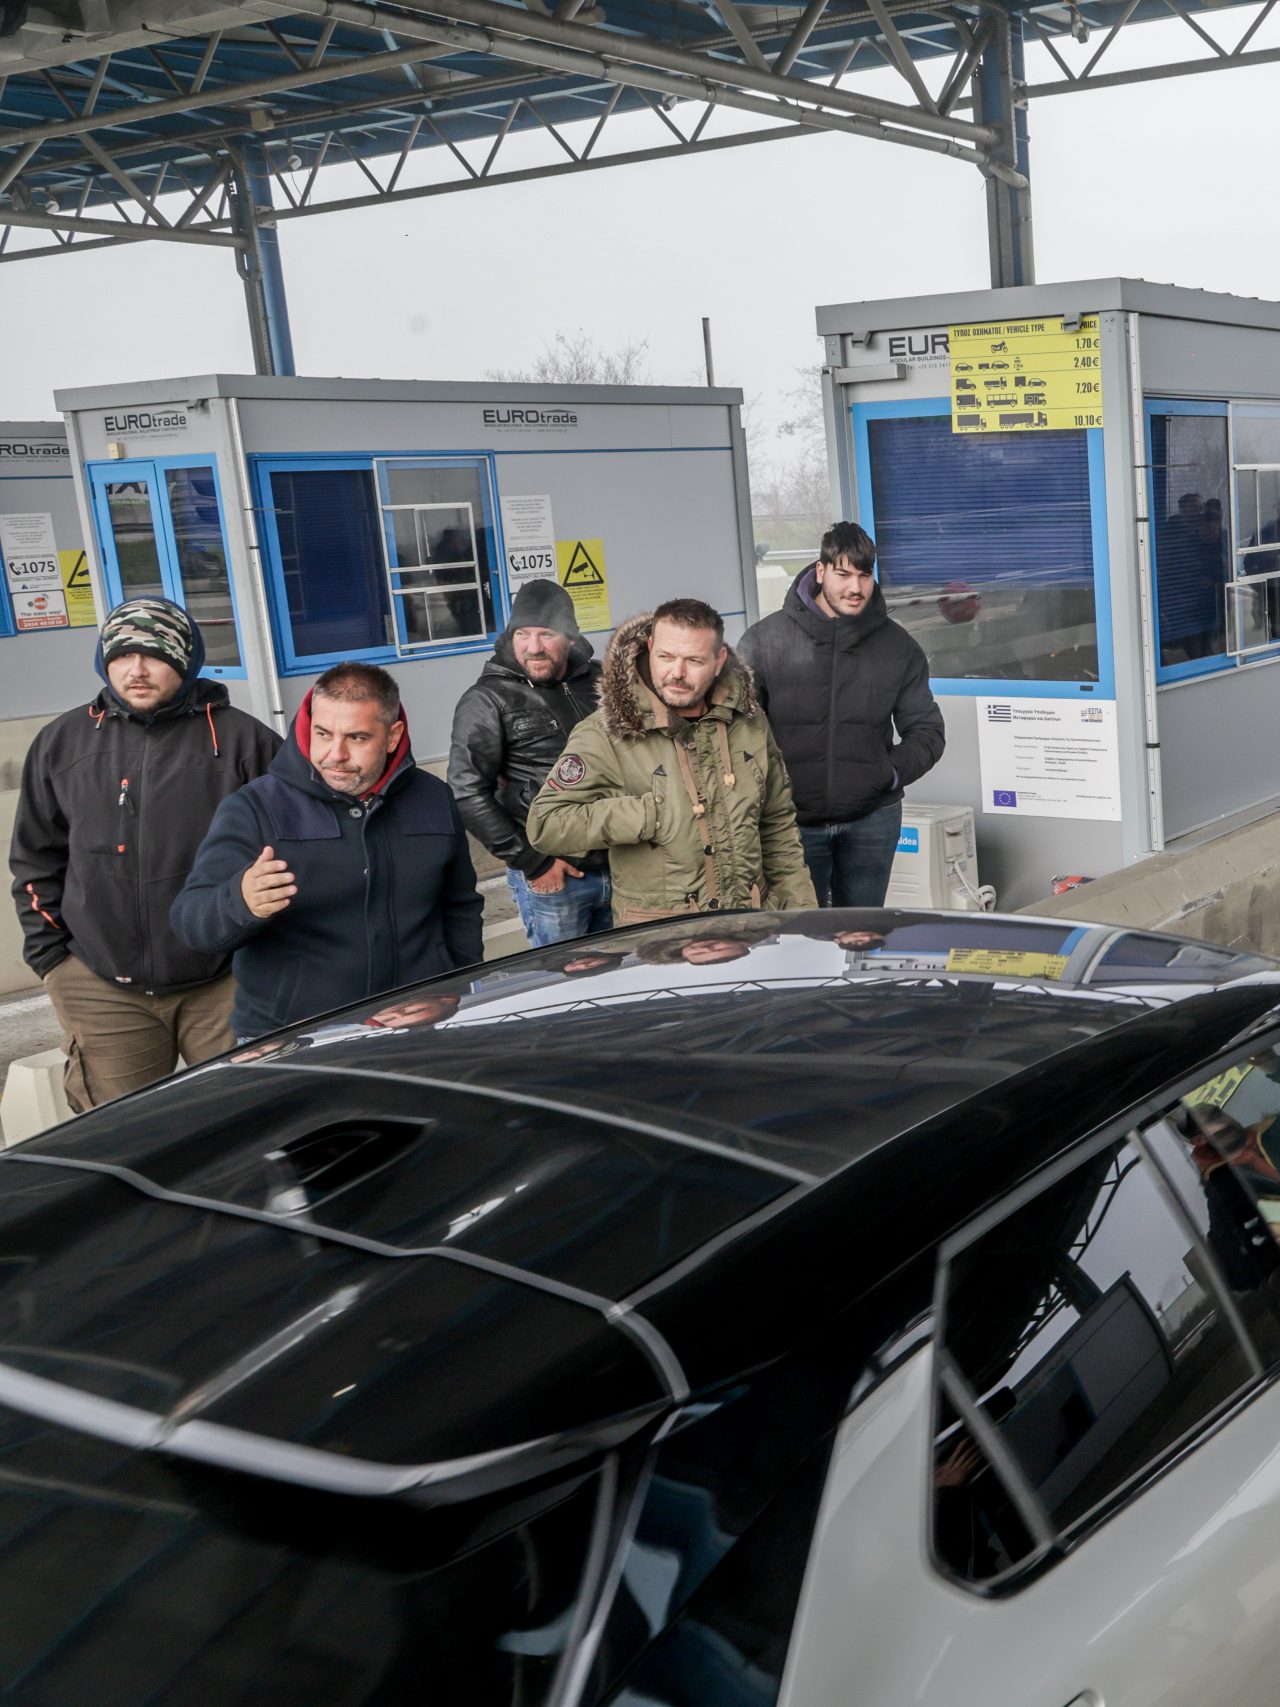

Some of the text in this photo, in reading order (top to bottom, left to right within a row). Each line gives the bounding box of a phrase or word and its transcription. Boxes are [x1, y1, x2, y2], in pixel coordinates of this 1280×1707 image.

[1006, 324, 1029, 334] VEHICLE
[1031, 323, 1045, 332] TYPE
[889, 334, 950, 357] EUR
[104, 413, 187, 431] EUROtrade
[483, 410, 577, 423] EUROtrade
[0, 444, 69, 455] ROtrade
[21, 561, 55, 573] 1075
[520, 554, 552, 569] 1075
[897, 836, 917, 846] idea
